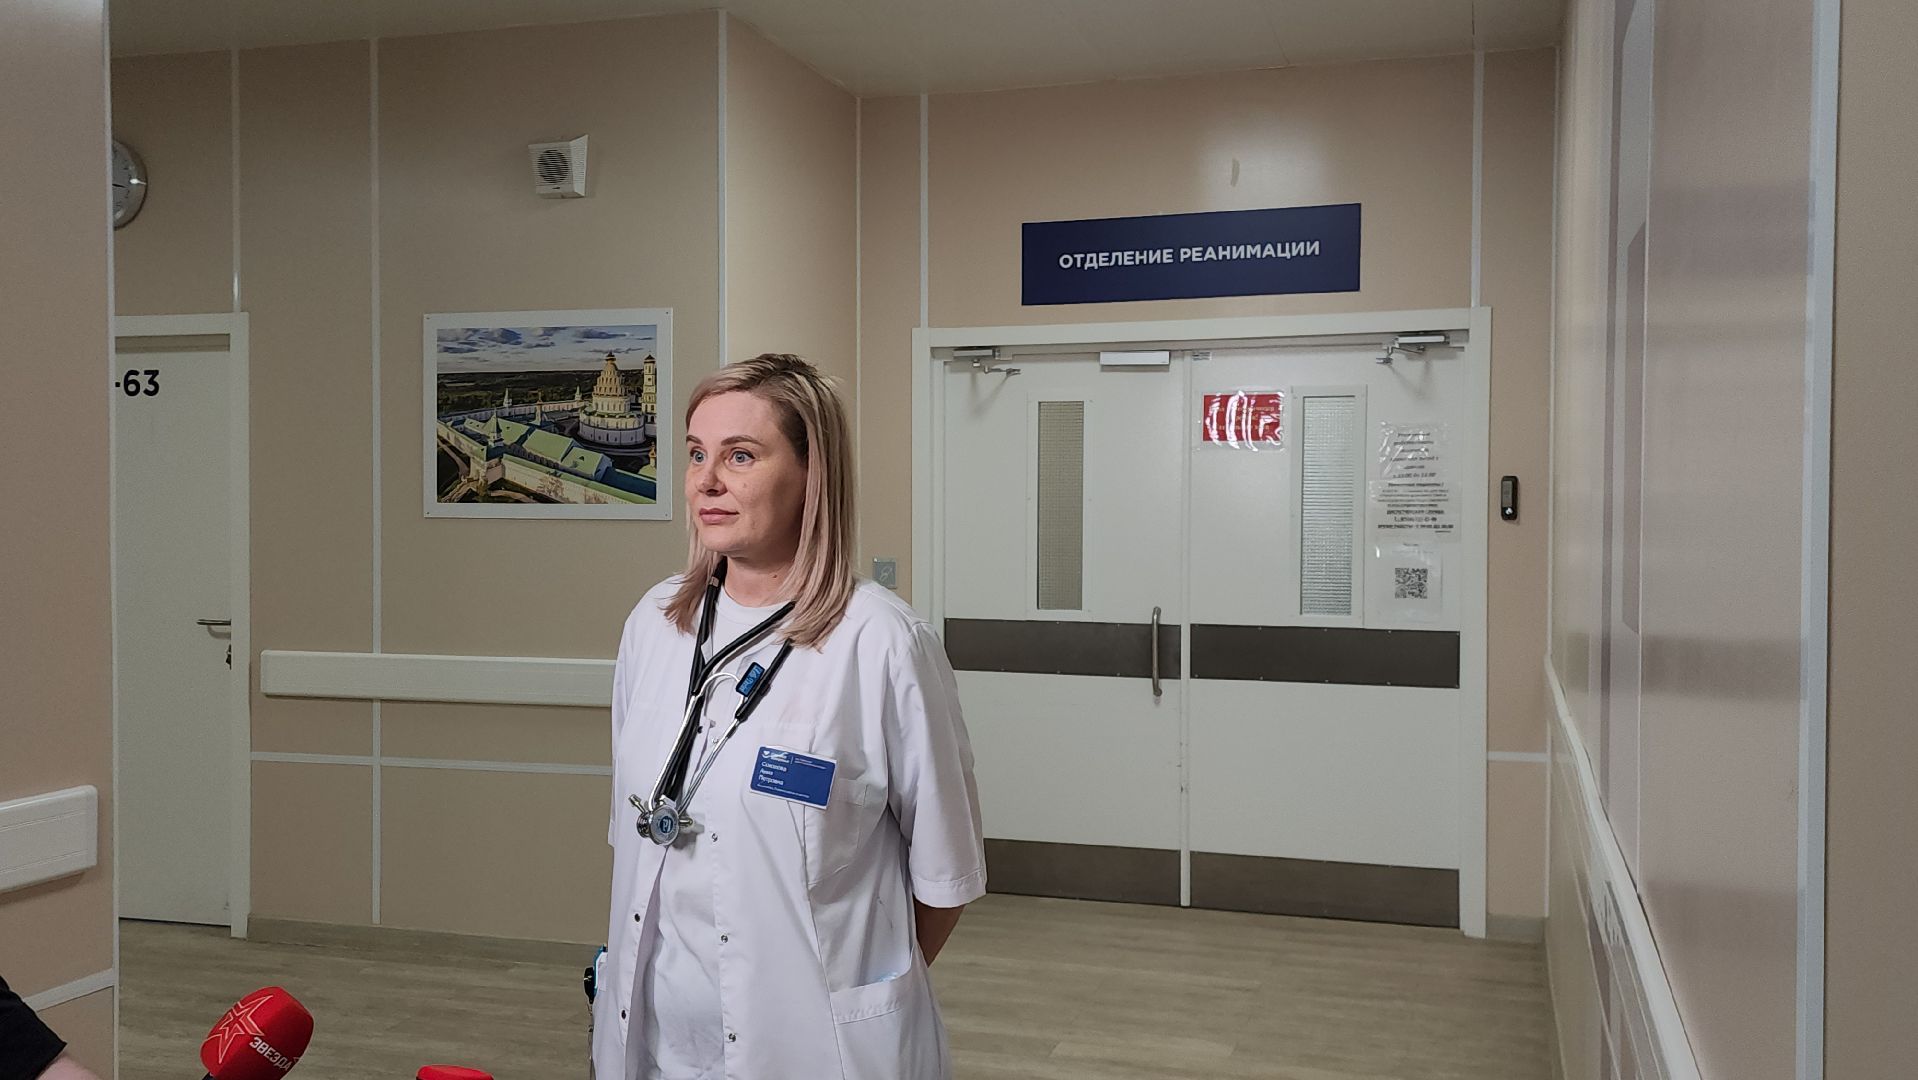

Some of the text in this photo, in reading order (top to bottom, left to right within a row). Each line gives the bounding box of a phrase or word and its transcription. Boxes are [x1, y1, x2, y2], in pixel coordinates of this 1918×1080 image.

[1059, 240, 1321, 270] ОТДЕЛЕНИЕ РЕАНИМАЦИИ
[249, 1036, 292, 1071] ЗВЕЗДА
